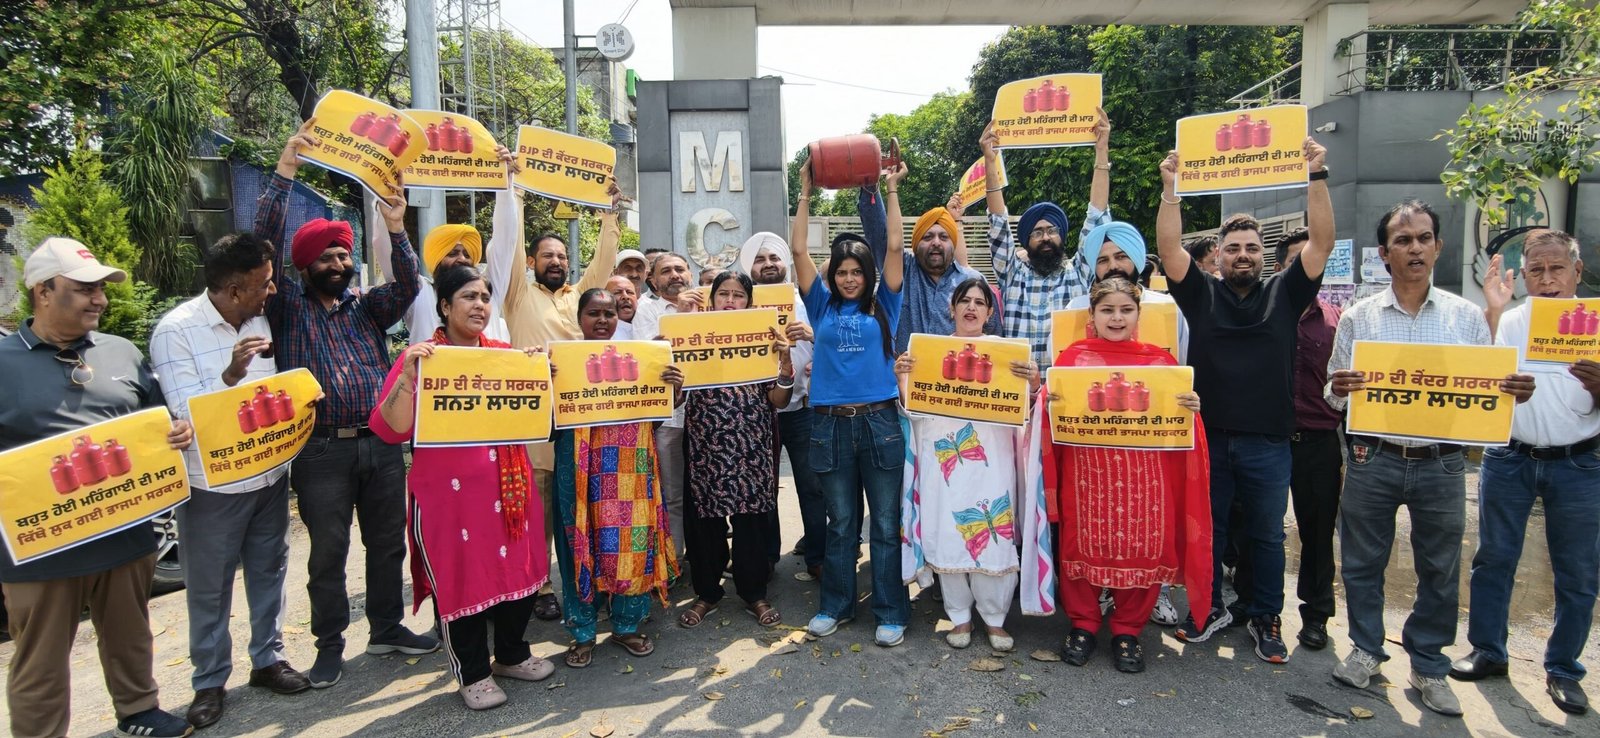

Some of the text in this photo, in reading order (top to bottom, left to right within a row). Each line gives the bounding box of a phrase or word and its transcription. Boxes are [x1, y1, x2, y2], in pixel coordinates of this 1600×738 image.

[998, 119, 1015, 127] ਬਹੁਤ
[1017, 116, 1032, 125] ਹੋਈ
[1033, 114, 1067, 124] ਮਹਿੰਗਾਈ
[1069, 114, 1080, 123] ਦੀ
[313, 126, 334, 139] ਬਹੁਤ
[335, 133, 353, 146] ਹੋਈ
[420, 154, 435, 165] ਹੋਈ
[437, 156, 472, 167] ਮਹਿੰਗਾਈ
[475, 158, 483, 168] ਦੀ
[485, 160, 500, 168] ਮਾਰ
[520, 145, 613, 174] BJP ਦੀ ਕੇਂਦਰ ਸਰਕਾਰ
[1184, 150, 1301, 169] ਬਹੁਤ ਹੋਈ ਮਹਿੰਗਾਈ ਦੀ ਮਾਰ
[526, 157, 607, 184] ਜਨਤਾ ਲਾਚਾਰ
[1181, 162, 1303, 181] ਕਿੱਥੇ ਲੁਕ ਗਈ ਭਾਜਪਾ ਸਰਕਾਰ
[672, 338, 685, 348] JP
[688, 334, 702, 346] ਦੀ
[705, 332, 732, 345] ਕੇਂਦਰ
[672, 344, 770, 363] ਜਨਤਾ ਲਾਚਾਰ
[424, 374, 549, 391] BJP ਦੀ ਕੇਂਦਰ ਸਰਕਾਰ
[1366, 369, 1508, 391] JP ਦੀ ਕੇਂਦਰ ਸਰਕਾ
[560, 384, 665, 401] ਬਹੁਤ ਹੋਈ ਮਹਿੰਗਾਈ ਦੀ ਮਾਰ
[914, 381, 1019, 401] ਬਹੁਤ ਹੋਈ ਮਹਿੰਗਾਈ ਦੀ ਮਾਰ
[1366, 387, 1499, 411] ਜਨਤਾ ਲਾਚਾਰ
[433, 395, 541, 411] ਜਨਤਾ ਲਾਚਾਰ
[559, 399, 668, 414] ਕਿੱਥੇ ਲੁਕ ਗਈ ਭਾਜਪਾ ਸਰਕਾਰ
[911, 391, 1021, 414] ਕਿੱਥੇ ਲੁਕ ਗਈ ਭਾਜਪਾ ਸਰਕਾਰ
[1058, 414, 1186, 426] ਬਹੁਤ ਹੋਈ ਮਹਿੰਗਾਈ ਦੀ ਮਾਰ
[1057, 425, 1189, 437] ਕਿੱਥੇ ਲੁਕ ਗਈ ਭਾਜਪਾ ਸਰਕਾਰ
[209, 446, 235, 459] ਬਹੁਤ
[236, 438, 256, 453] ਹੋਈ
[257, 424, 296, 446] ਮਹਿੰਗਾਈ
[210, 460, 232, 474] ਕਿੱਥੇ
[234, 455, 252, 470] ਲੁਕ
[254, 446, 274, 461] ਗਈ
[15, 466, 177, 527] ਬਹੁਤ ਹੋਈ ਮਹਿੰਗਾਈ ਦੀ ਮਾਰ
[17, 480, 183, 546] ਕਿੱਥੇ ਲੁਕ ਗਈ ਭਾਜਪਾ ਸਰਕਾਰ
